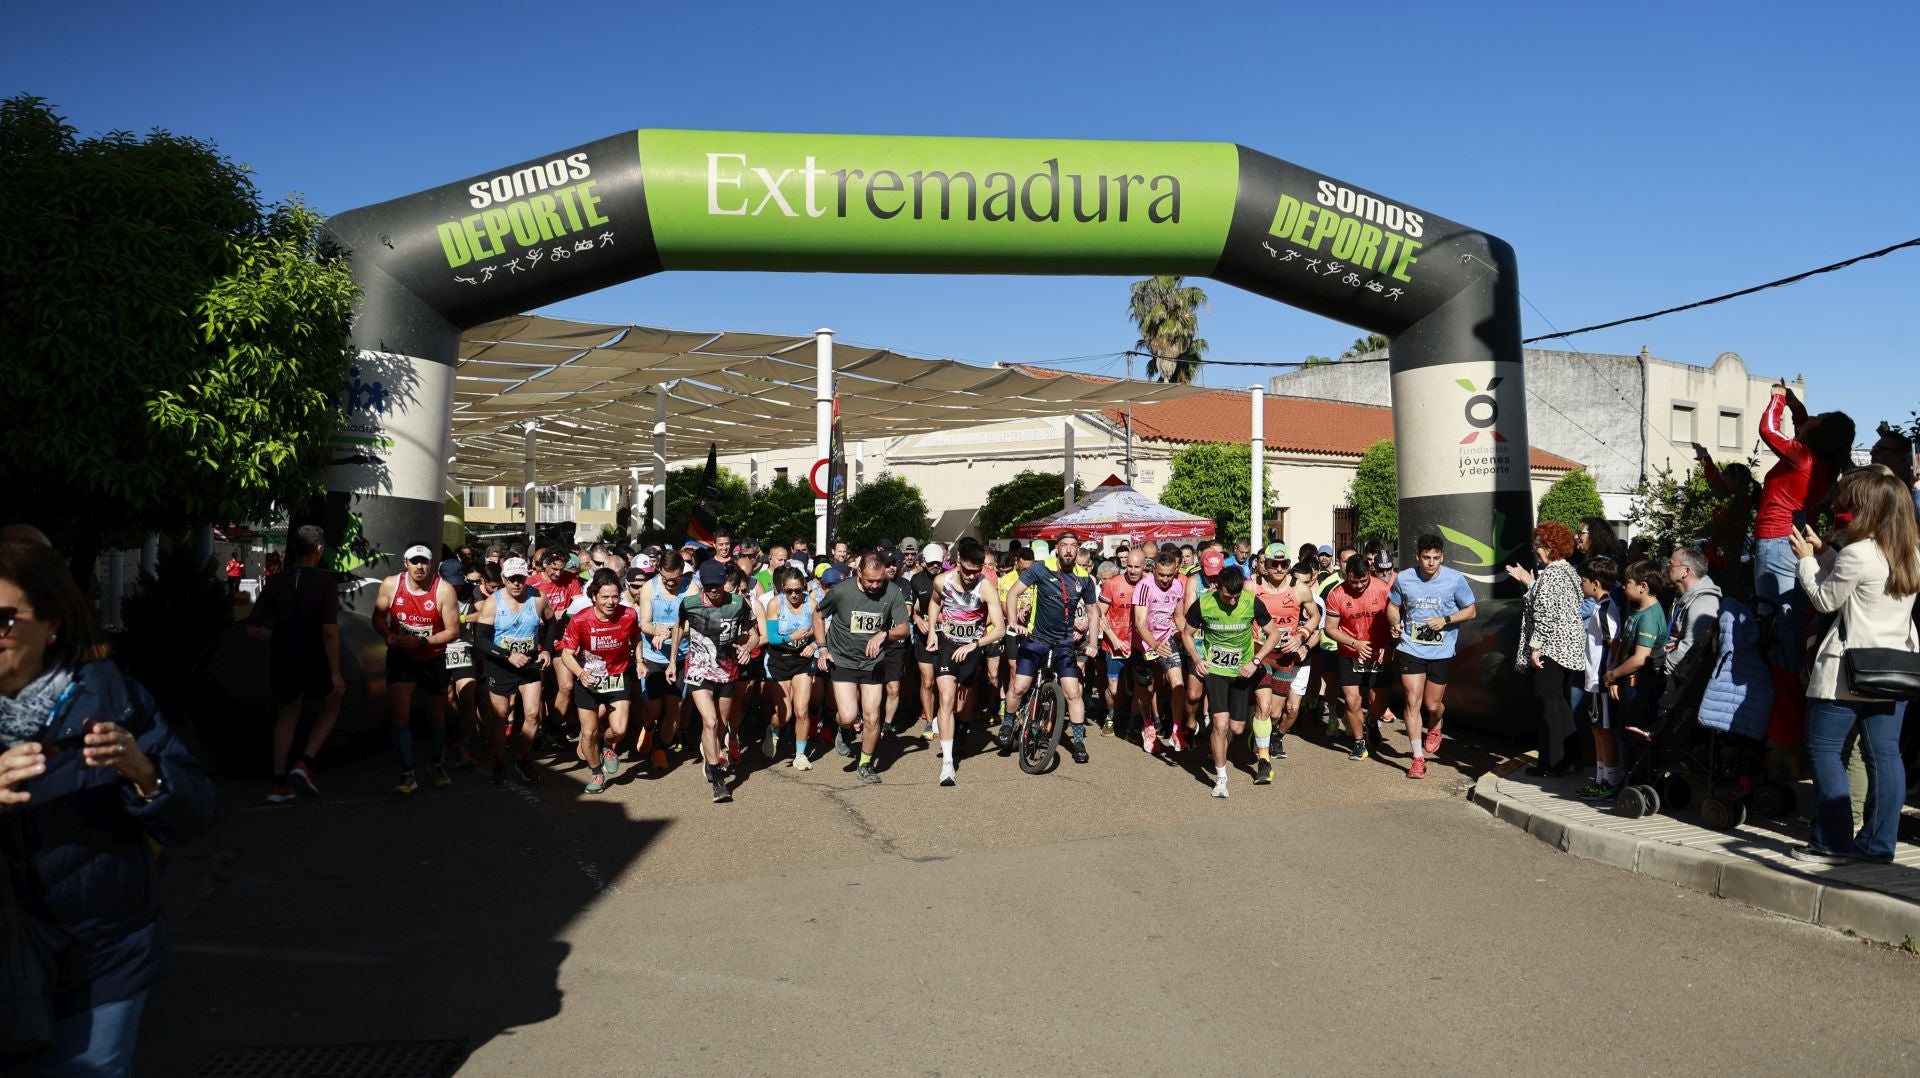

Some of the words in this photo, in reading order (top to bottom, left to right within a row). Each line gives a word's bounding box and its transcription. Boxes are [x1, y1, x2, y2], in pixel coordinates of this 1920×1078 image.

[469, 152, 590, 209] SOMOS
[705, 152, 1181, 224] Extremadura
[1316, 180, 1424, 238] SOMOS
[436, 179, 609, 269] DEPORTE
[1268, 193, 1423, 283] DEPORTE
[1459, 446, 1509, 454] fundación
[1458, 456, 1510, 468] jóvenes
[1459, 469, 1466, 477] y
[1469, 466, 1510, 476] deporte
[408, 613, 432, 623] cicom
[856, 616, 882, 632] 184
[949, 623, 974, 637] 200
[1211, 650, 1240, 667] 246
[594, 674, 621, 690] 217
